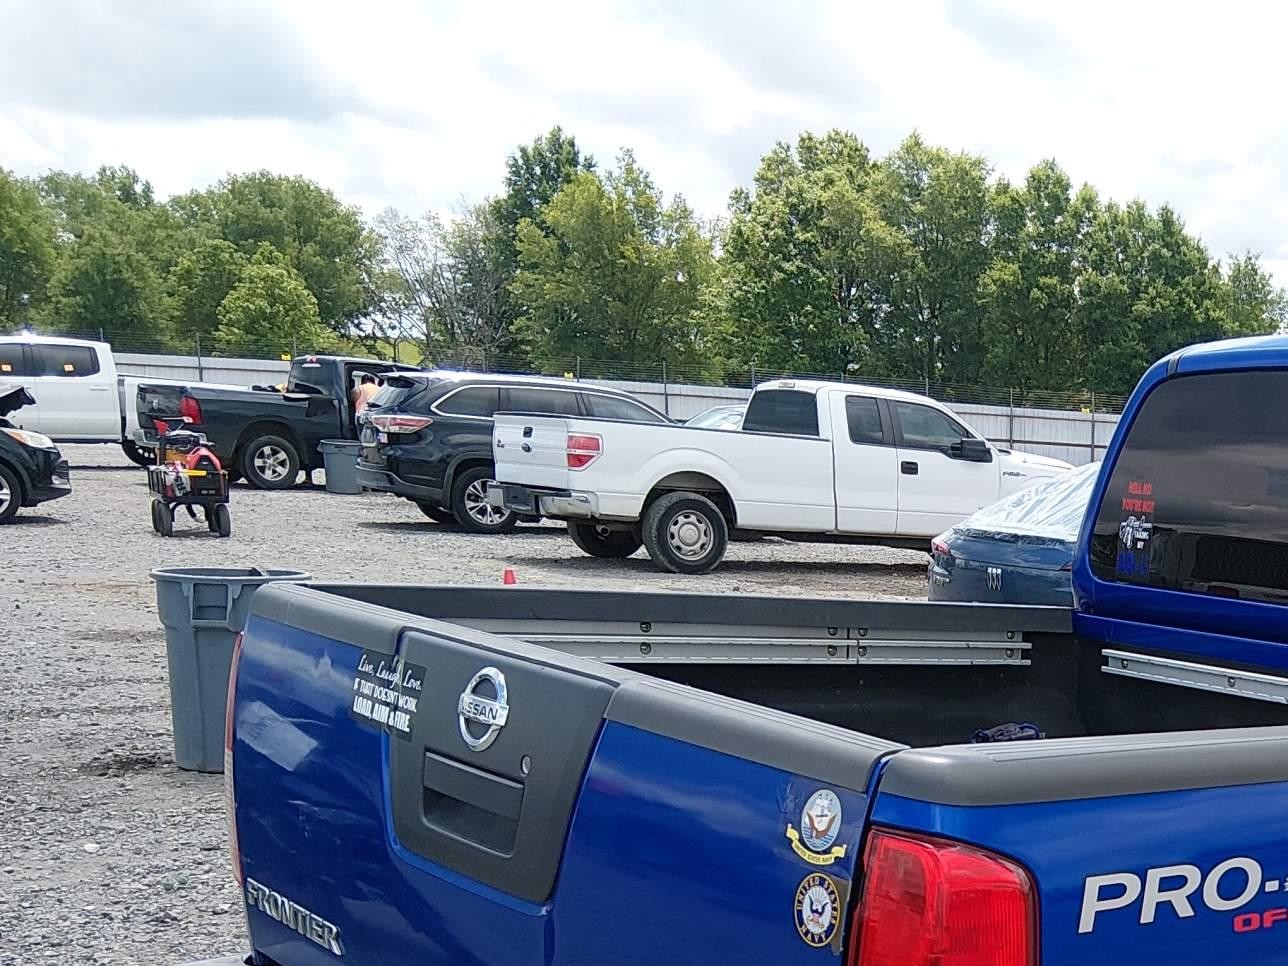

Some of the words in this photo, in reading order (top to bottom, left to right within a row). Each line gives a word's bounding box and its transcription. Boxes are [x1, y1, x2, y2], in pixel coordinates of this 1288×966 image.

[360, 680, 375, 697] THAT
[372, 703, 389, 724] AIM
[796, 876, 820, 910] UNITED
[824, 877, 838, 925] STATES
[246, 877, 342, 956] FRONTIER
[800, 926, 827, 943] NAVY
